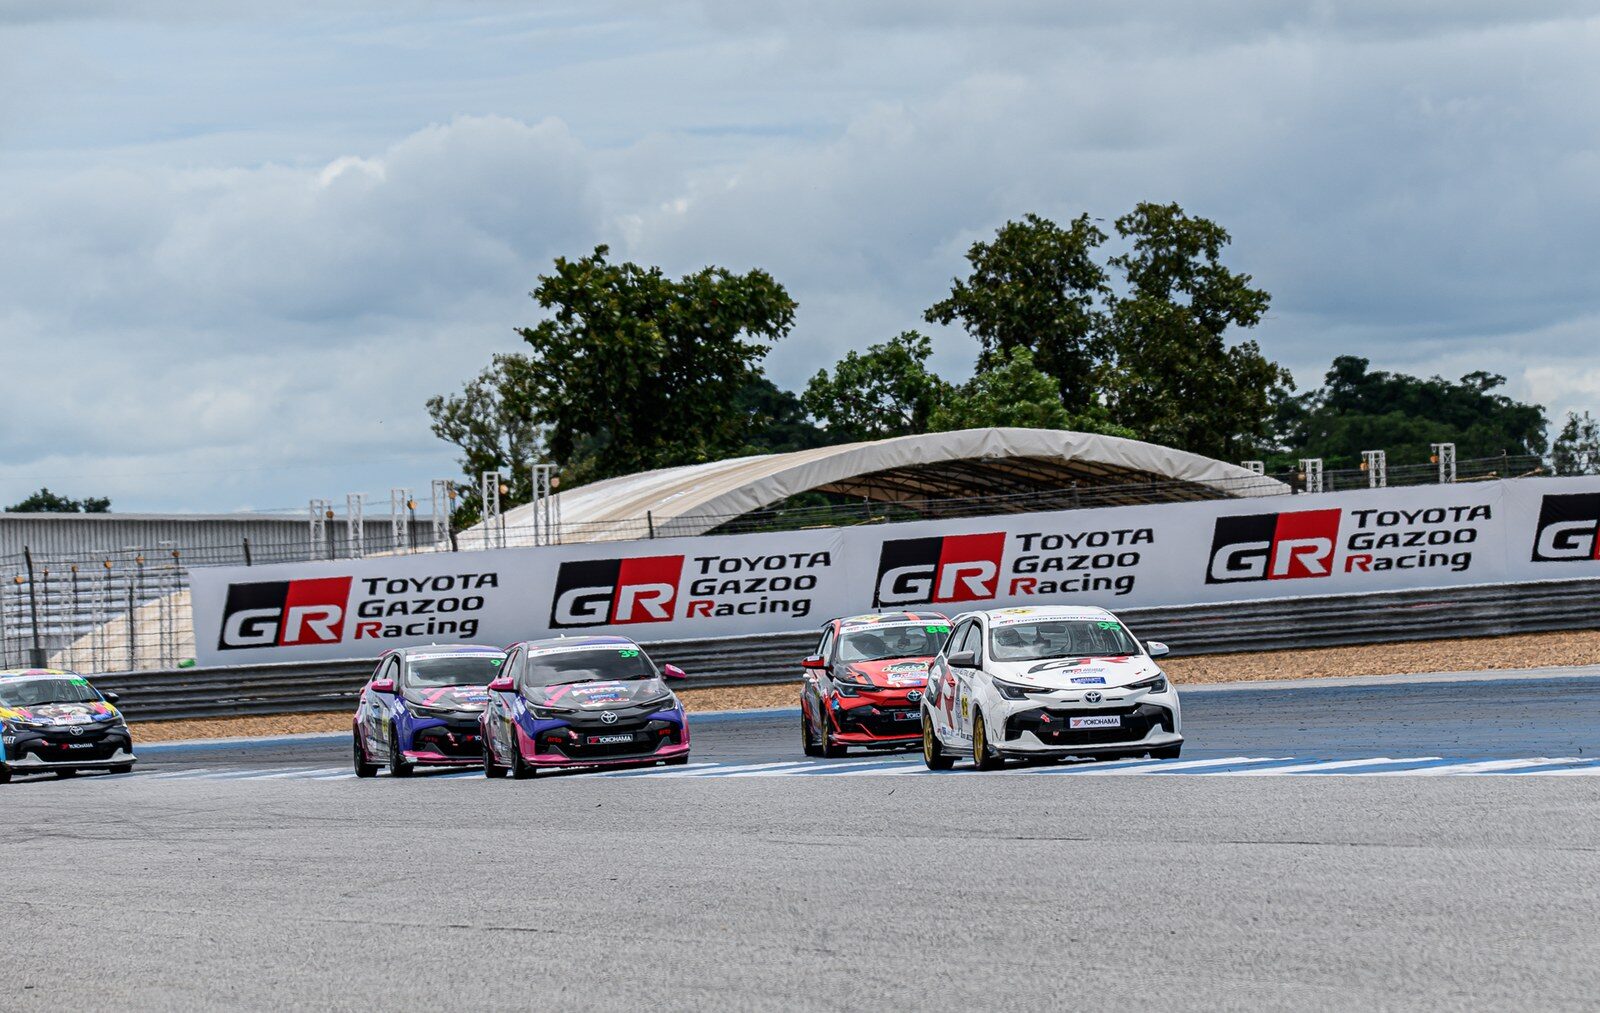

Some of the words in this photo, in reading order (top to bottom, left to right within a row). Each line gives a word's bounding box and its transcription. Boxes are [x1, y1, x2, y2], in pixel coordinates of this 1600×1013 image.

[1350, 504, 1493, 529] TOYOTA
[1015, 528, 1155, 553] TOYOTA
[1346, 526, 1478, 552] GAZOO
[1537, 519, 1600, 558] G
[693, 551, 832, 575] TOYOTA
[1011, 550, 1141, 575] GAZOO
[1211, 537, 1332, 580] GR
[1344, 550, 1472, 574] Racing
[361, 572, 499, 597] TOYOTA
[689, 574, 818, 598] GAZOO
[879, 560, 997, 603] GR
[1008, 573, 1136, 597] Racing
[356, 596, 485, 620] GAZOO
[555, 583, 675, 625] GR
[685, 598, 812, 619] Racing
[223, 604, 343, 646] GR
[353, 618, 480, 641] Racing
[1097, 621, 1121, 631] 95
[618, 649, 639, 658] 39
[1083, 716, 1119, 727] YOKOHAMA
[599, 736, 632, 744] YOKOHAMA
